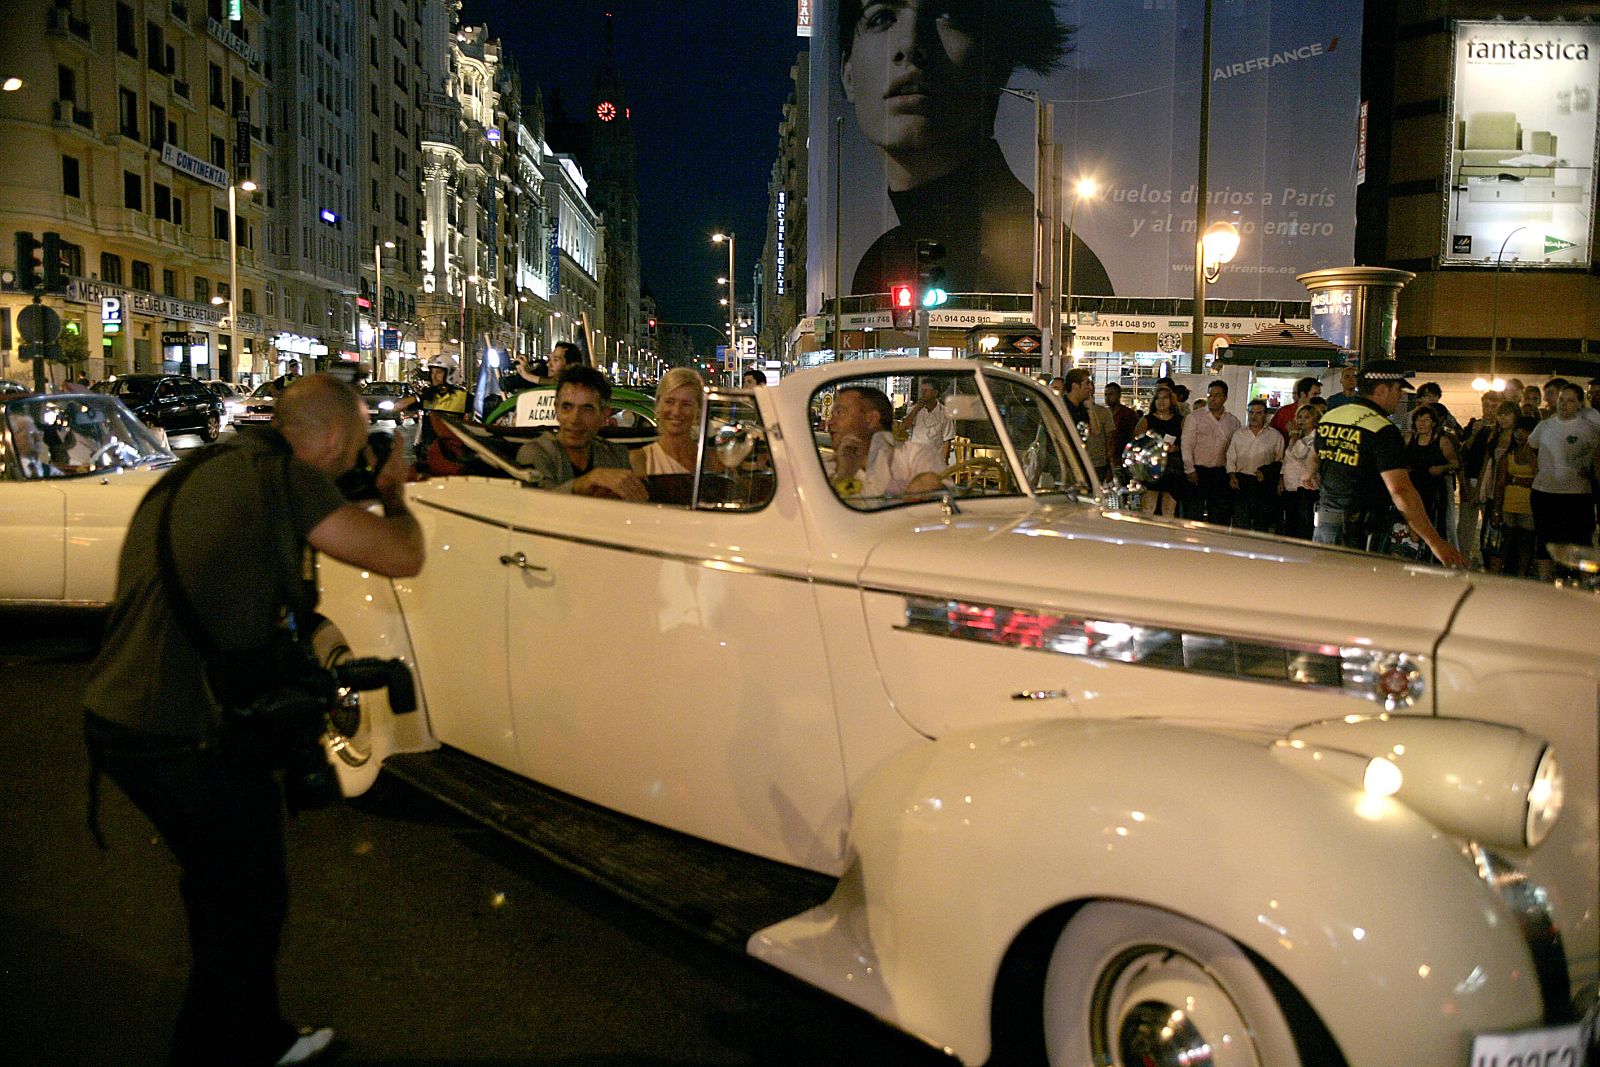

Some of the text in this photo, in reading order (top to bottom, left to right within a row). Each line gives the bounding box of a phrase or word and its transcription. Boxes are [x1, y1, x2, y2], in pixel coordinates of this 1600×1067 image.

[1213, 43, 1323, 81] AIRFRANCE
[176, 152, 227, 186] CONTINENTAL
[1261, 191, 1273, 206] a
[1281, 187, 1336, 207] París
[1129, 213, 1334, 238] y al mdo entero
[134, 295, 168, 314] ESCUELA
[171, 302, 180, 316] DE
[1312, 293, 1352, 306] MSUNG
[944, 315, 958, 323] 914
[960, 315, 976, 324] 048
[1109, 319, 1124, 329] 914
[1125, 320, 1141, 329] 048
[1142, 320, 1156, 329] 910
[536, 395, 556, 406] ANT
